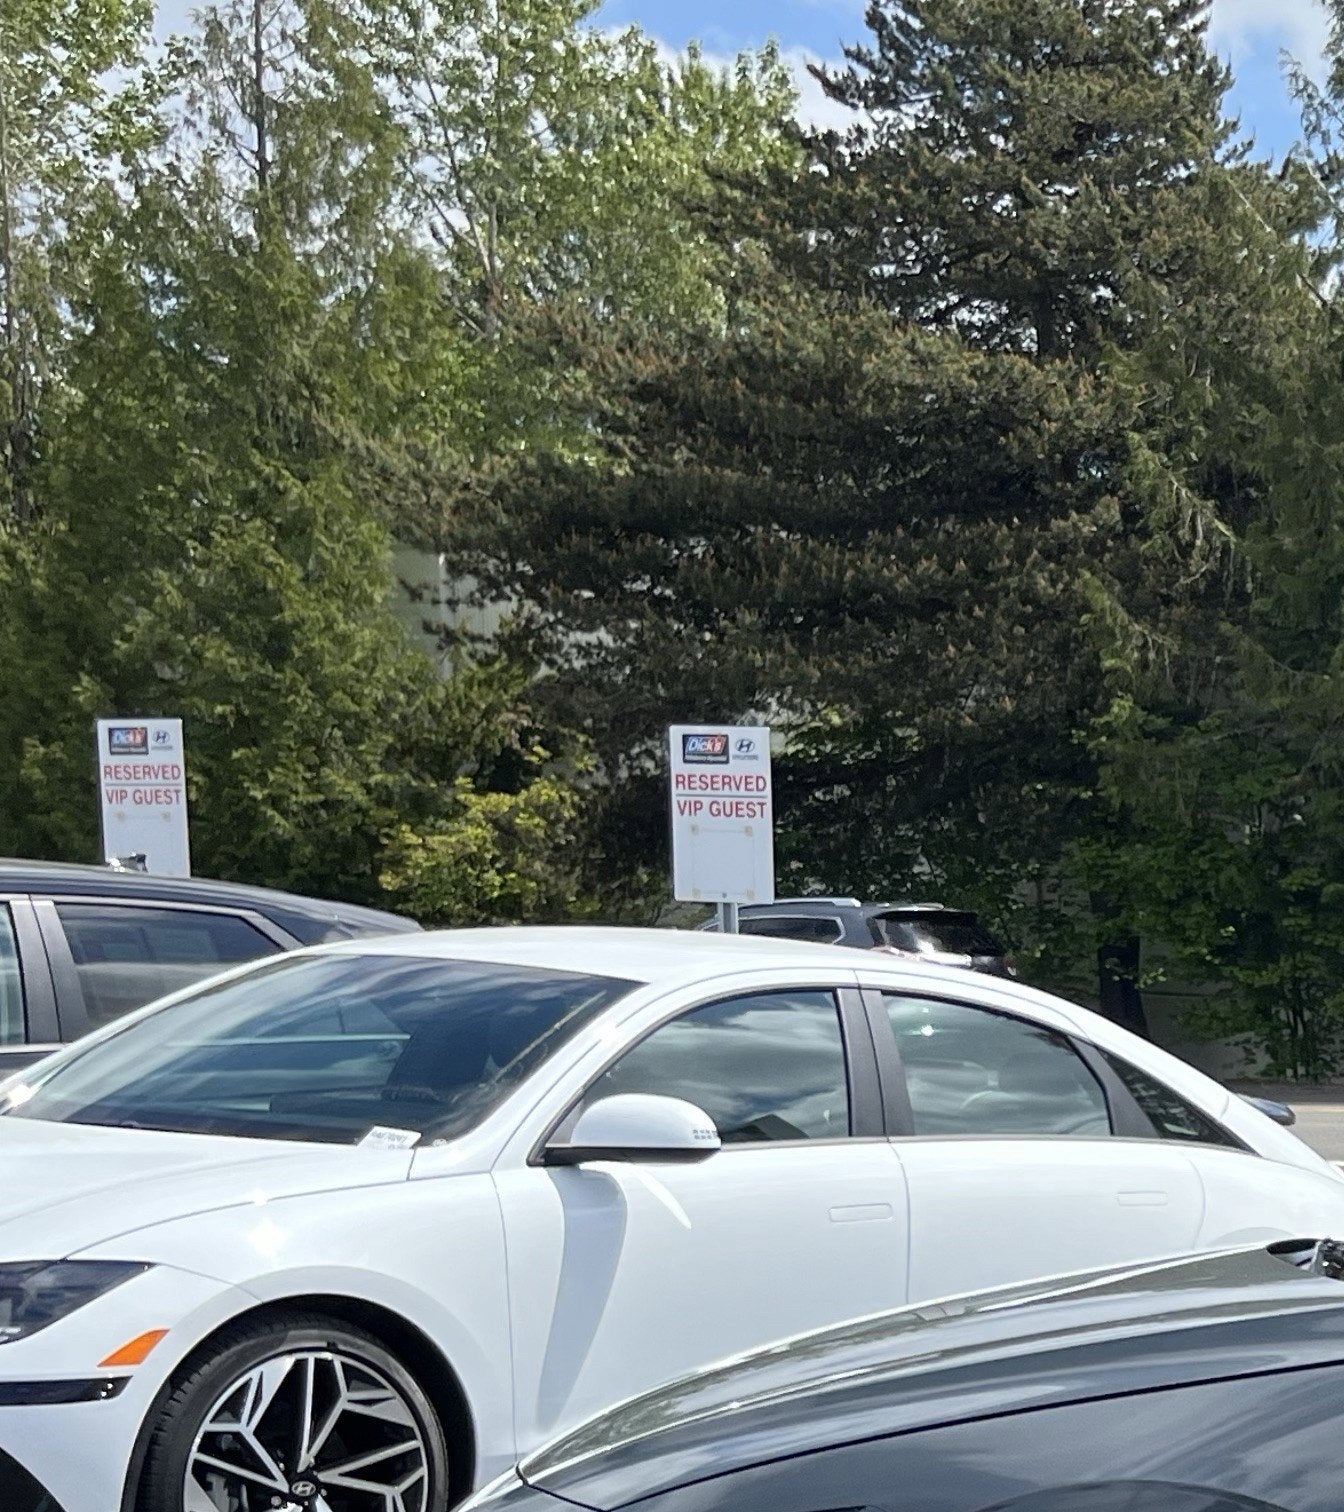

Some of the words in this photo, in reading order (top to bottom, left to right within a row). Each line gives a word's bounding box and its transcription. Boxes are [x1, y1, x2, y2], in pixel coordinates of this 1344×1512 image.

[104, 765, 181, 780] RESERVED
[675, 774, 767, 792] RESERVED
[106, 789, 128, 805] VIP
[133, 789, 182, 805] GUEST
[677, 800, 703, 816] VIP
[709, 801, 767, 819] GUEST
